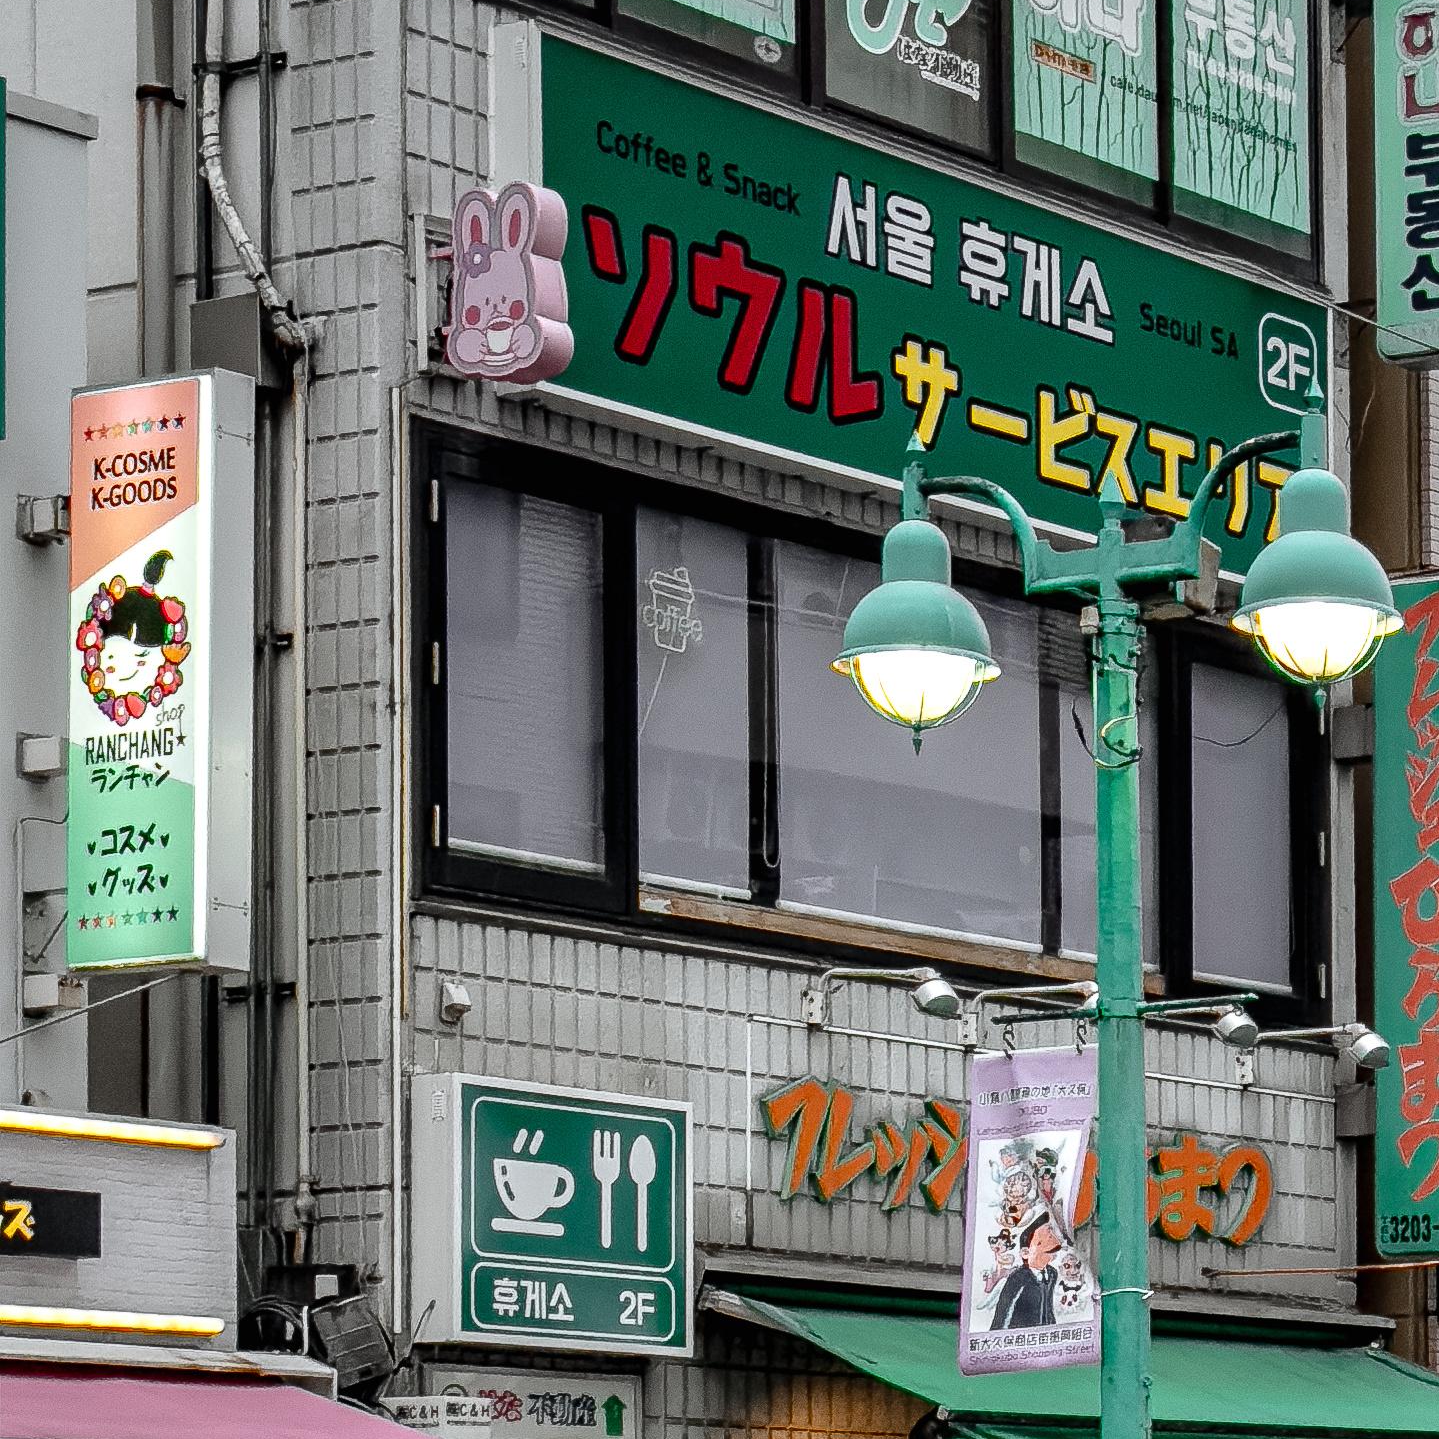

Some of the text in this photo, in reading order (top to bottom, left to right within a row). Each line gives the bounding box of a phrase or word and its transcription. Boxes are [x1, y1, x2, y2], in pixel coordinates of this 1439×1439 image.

[595, 120, 801, 217] Coffee & Snack
[826, 175, 1116, 346] 서울 휴게소
[1139, 304, 1314, 394] Seoul SA 2F
[93, 447, 177, 480] K-COSME
[91, 475, 178, 510] K-GOODS
[642, 603, 703, 643] Coffee
[155, 703, 185, 729] shop
[84, 727, 175, 767] RANCHANG
[90, 762, 172, 794] ランチャン
[100, 821, 156, 855] コスメ
[101, 865, 156, 896] グッズ
[491, 1275, 576, 1325] 휴게소
[618, 1289, 656, 1326] 2F
